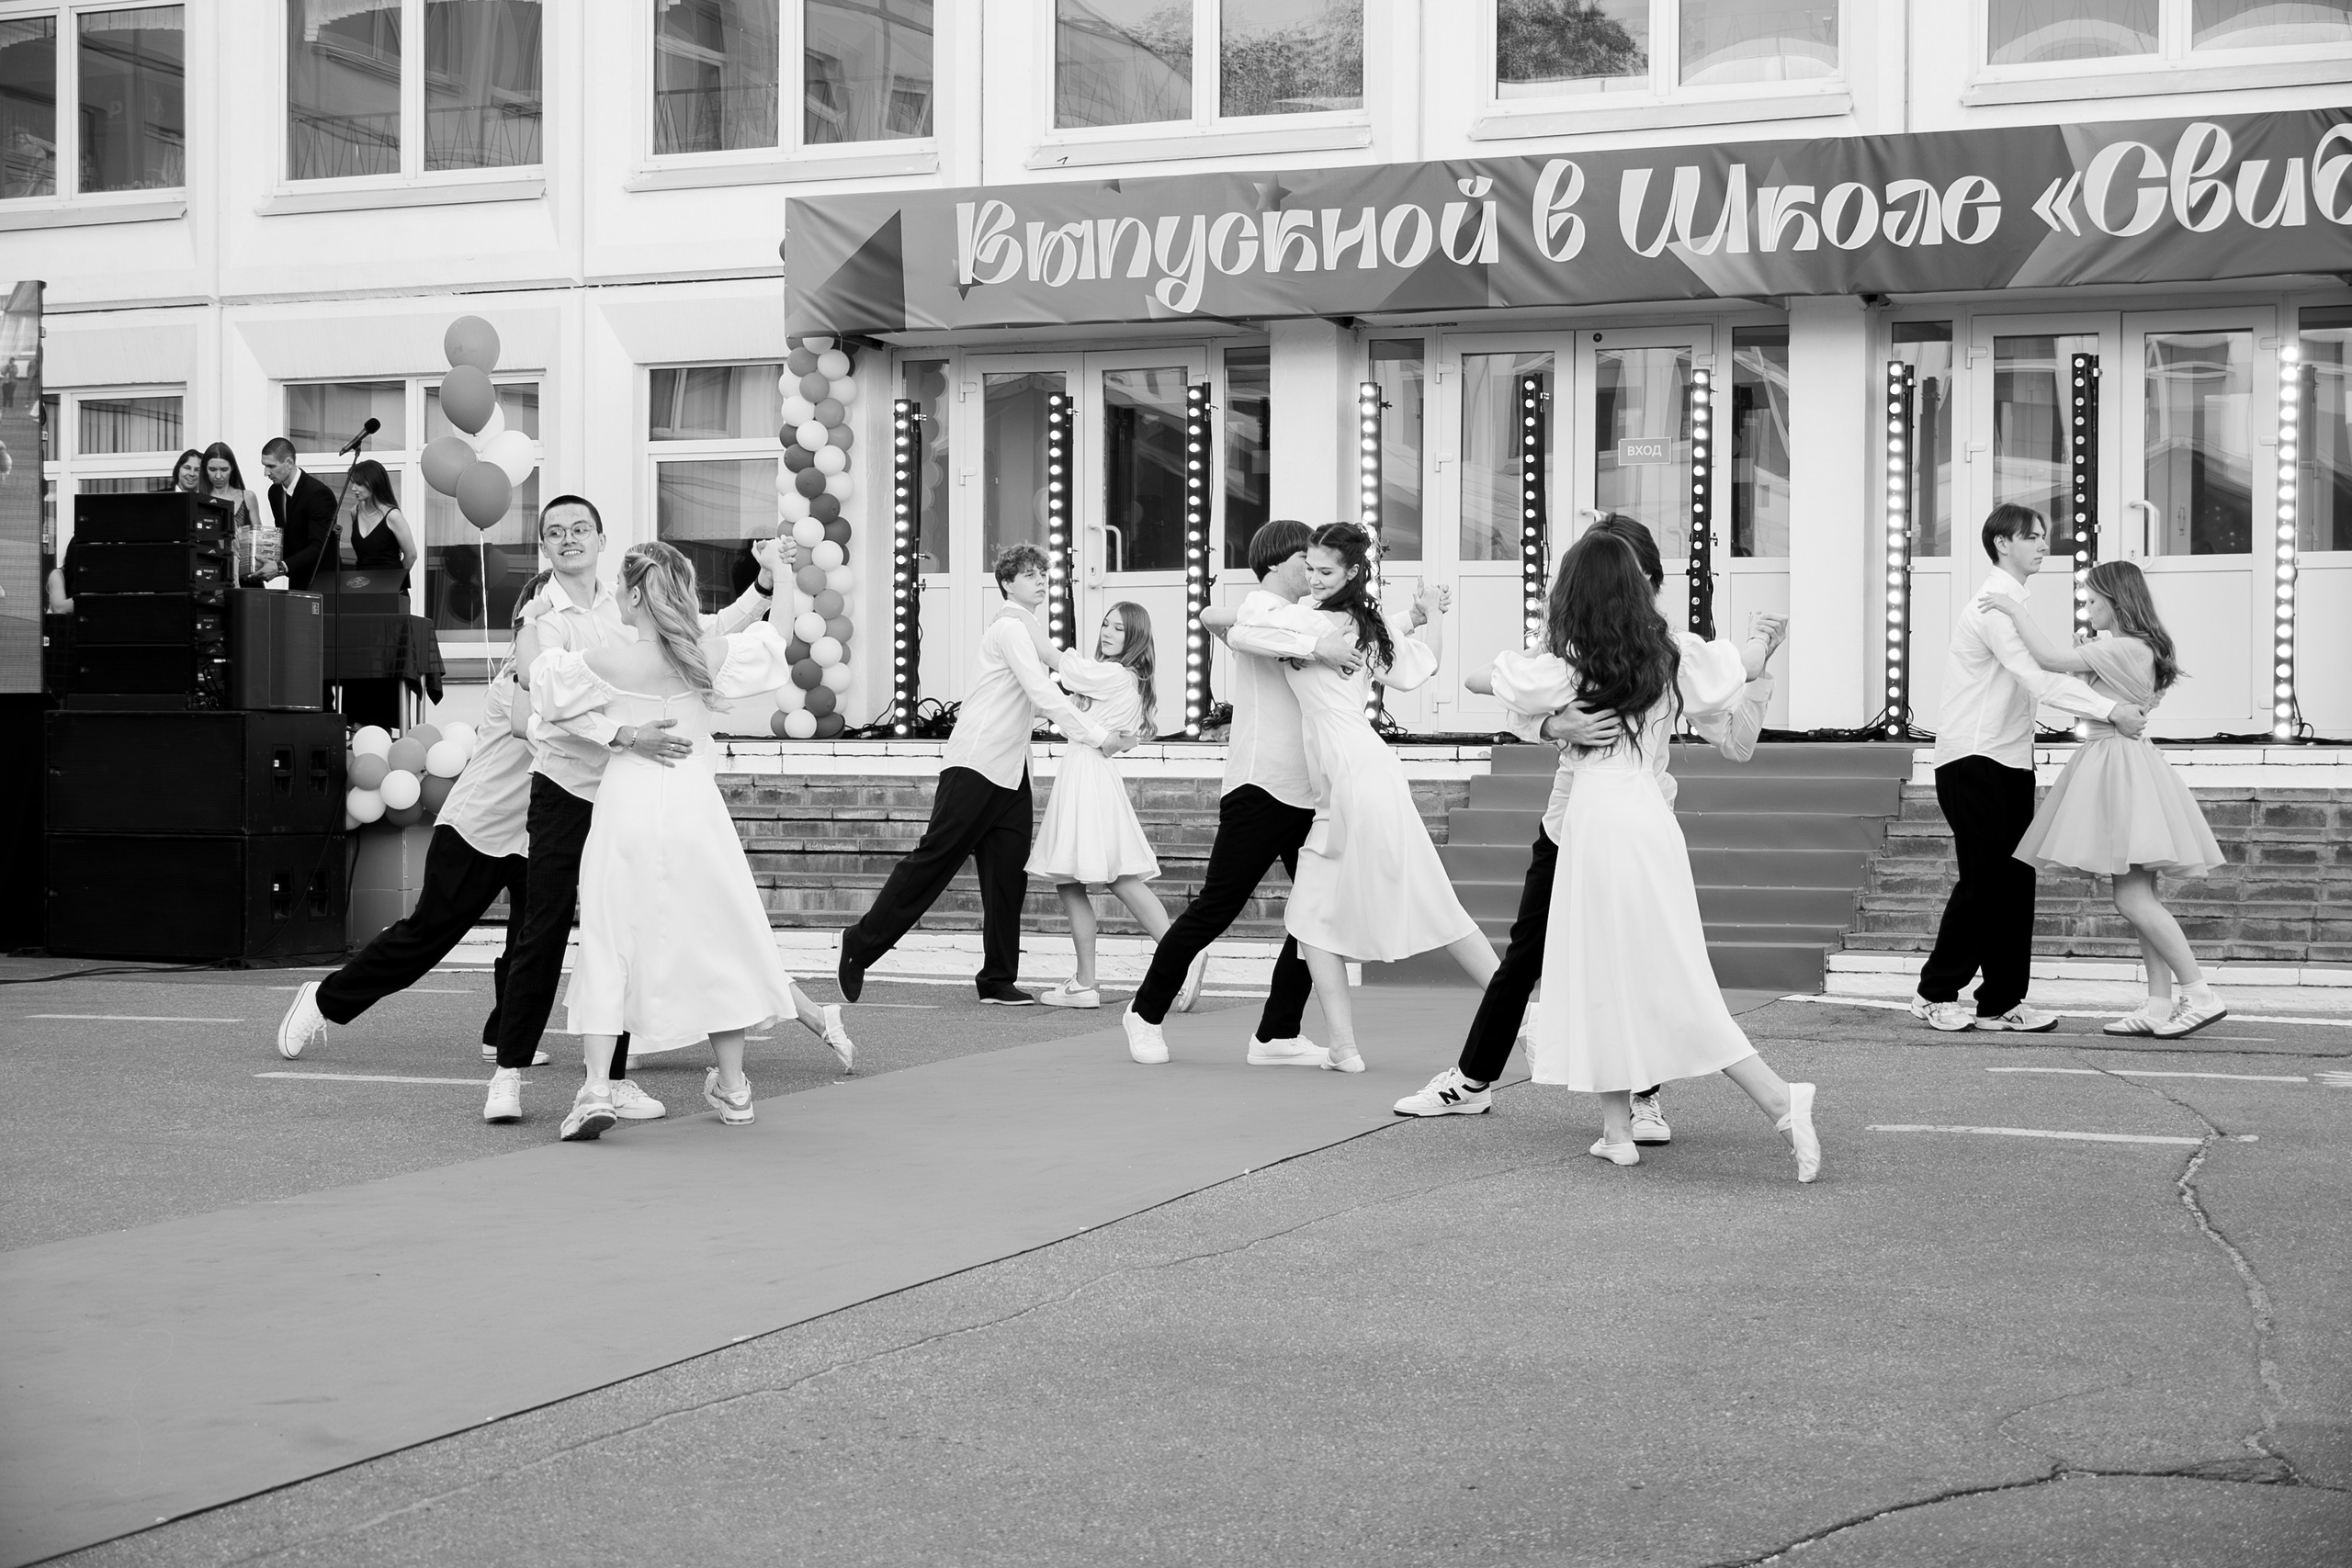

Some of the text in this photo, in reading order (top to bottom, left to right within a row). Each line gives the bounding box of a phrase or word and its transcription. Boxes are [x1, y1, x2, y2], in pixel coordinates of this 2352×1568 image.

[956, 175, 1499, 313] Выпускной
[1619, 164, 2002, 257] Школе
[1627, 445, 1662, 457] ВХОД
[1438, 1087, 1462, 1105] N
